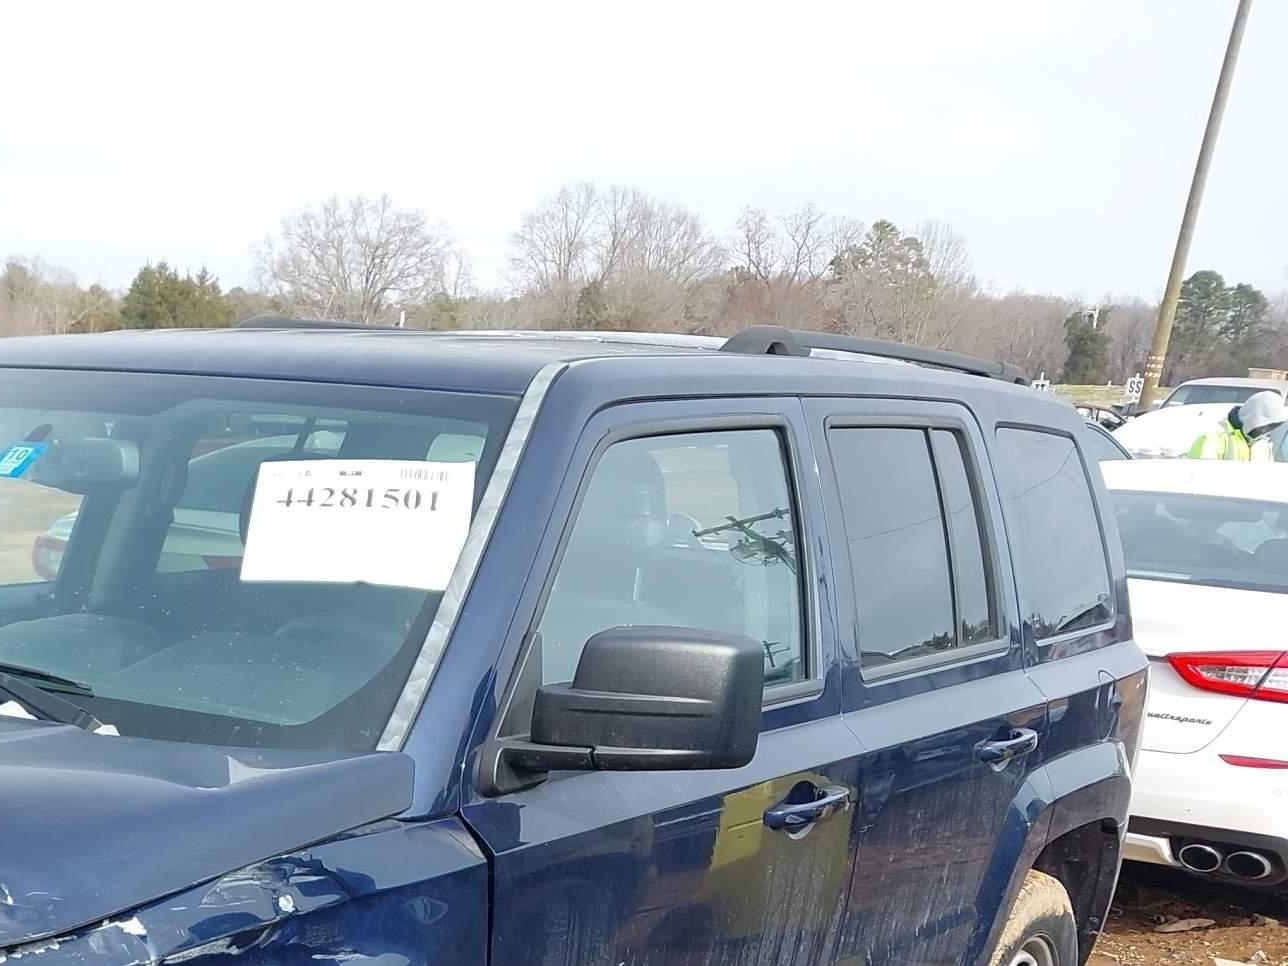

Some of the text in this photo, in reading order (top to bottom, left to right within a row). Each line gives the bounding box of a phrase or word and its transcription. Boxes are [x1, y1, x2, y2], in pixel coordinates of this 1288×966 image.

[1128, 380, 1142, 394] SS
[276, 486, 439, 512] 44281501
[1146, 711, 1213, 726] uattroporte
